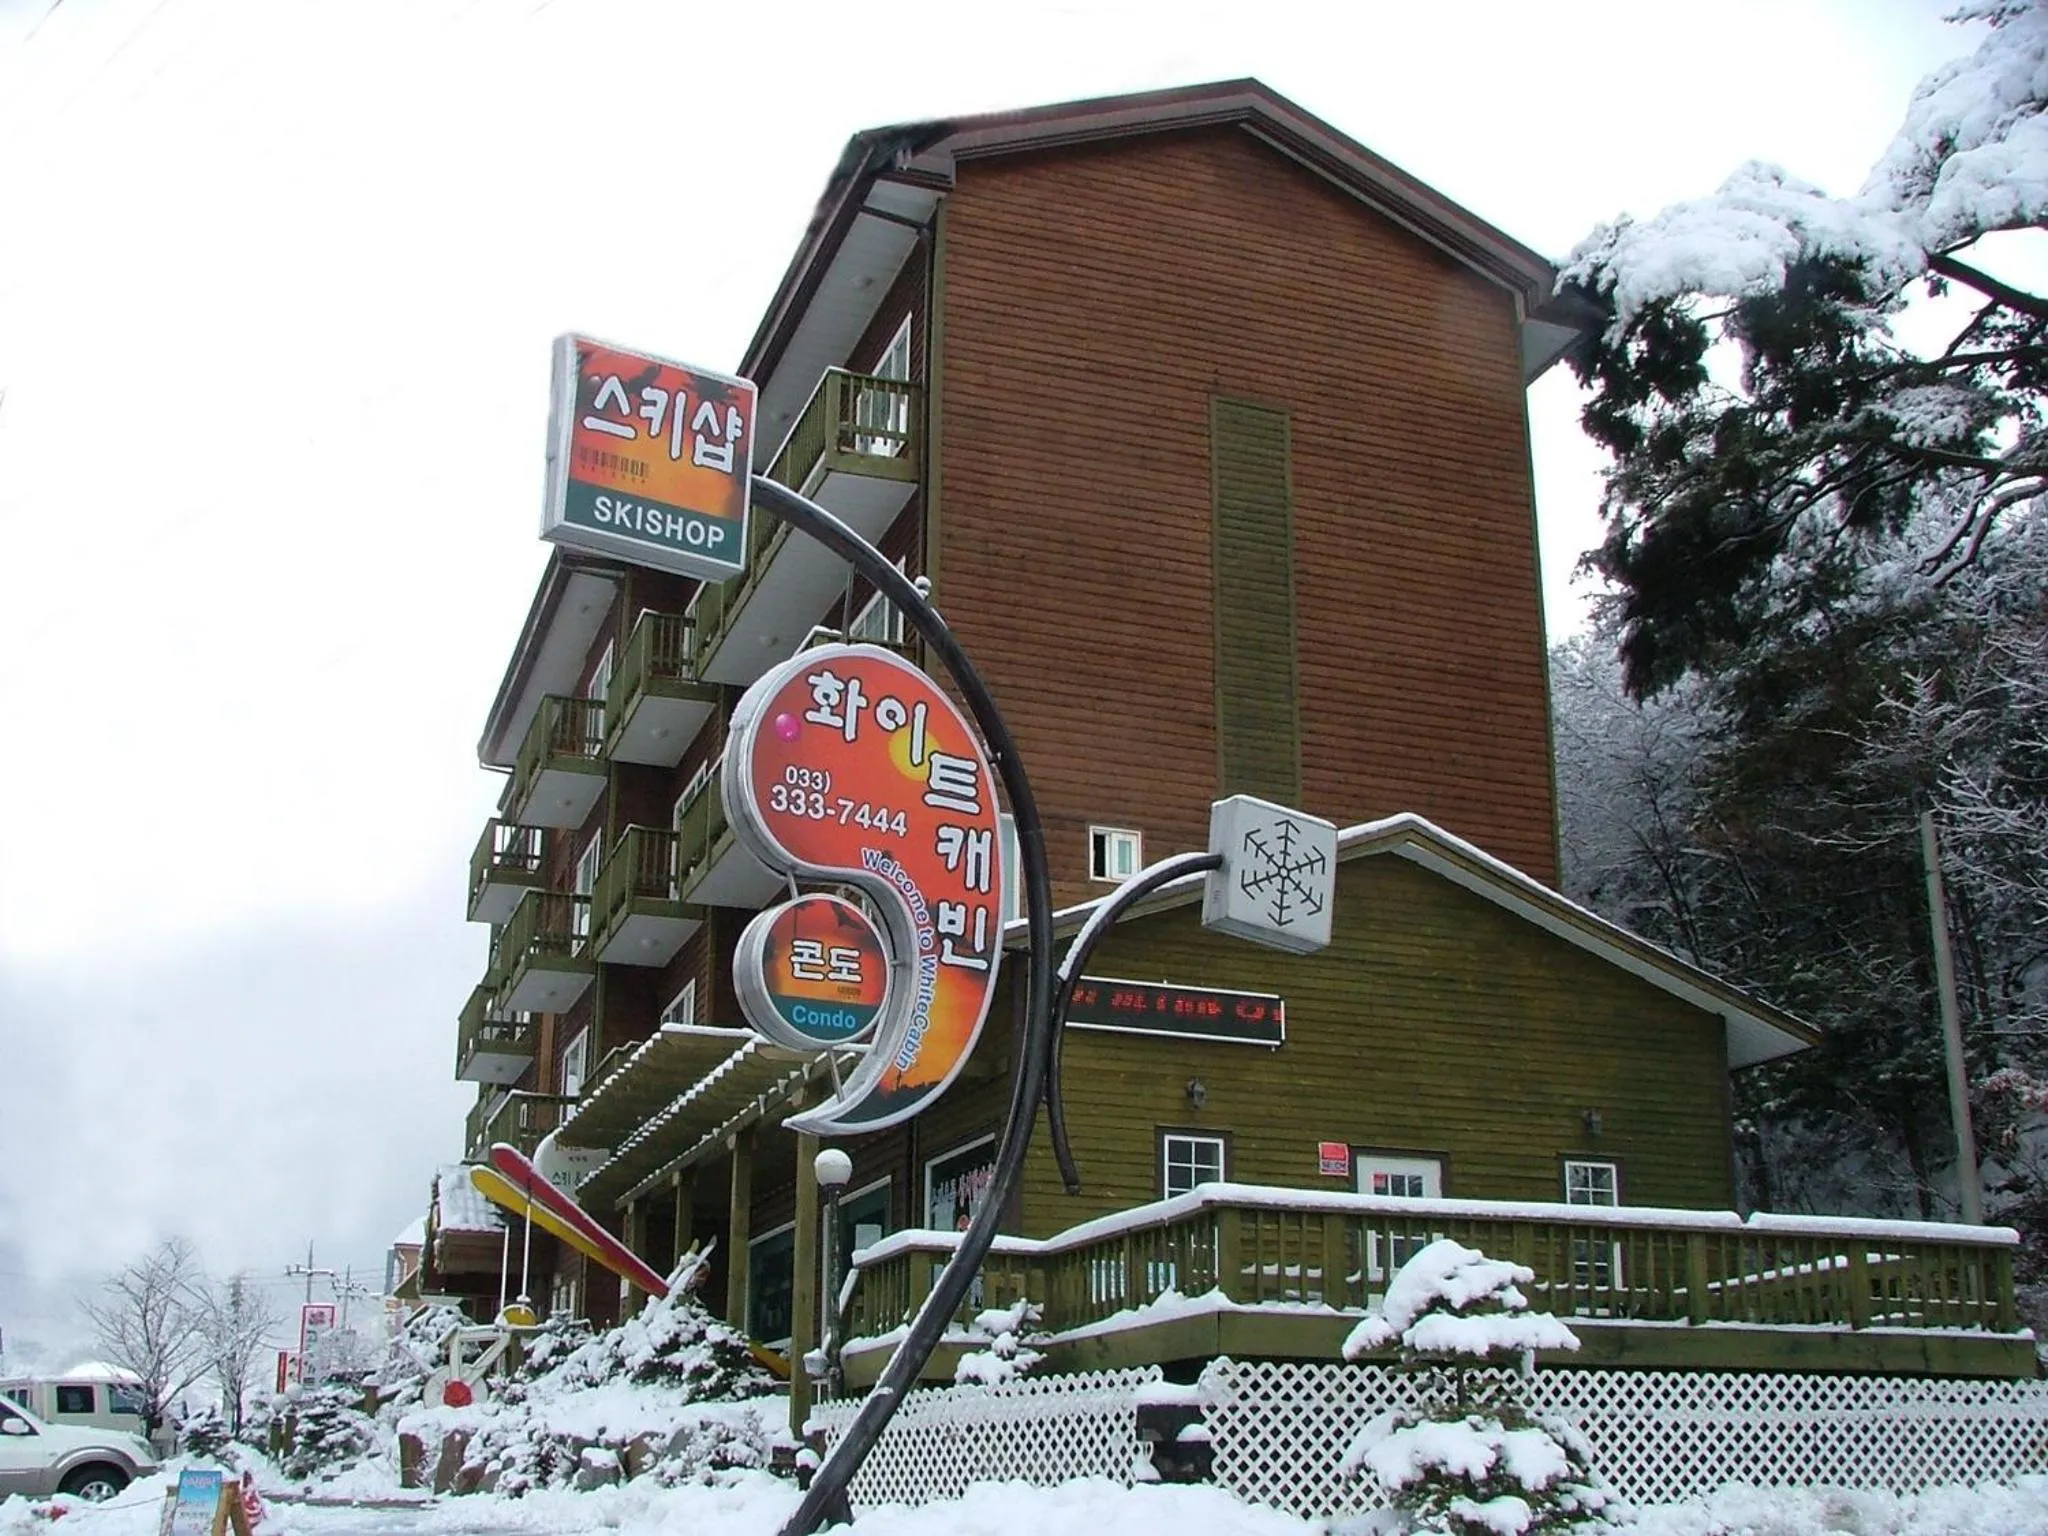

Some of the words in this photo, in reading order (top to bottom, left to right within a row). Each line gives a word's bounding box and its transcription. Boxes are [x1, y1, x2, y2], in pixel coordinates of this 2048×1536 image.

[582, 374, 744, 474] 스키샵
[593, 495, 726, 549] SKISHOP
[785, 765, 831, 794] 033)
[769, 784, 908, 837] 333-7444
[861, 847, 930, 924] Welcome
[919, 925, 935, 951] to
[789, 938, 864, 984] 콘도
[792, 1004, 857, 1029] Condo
